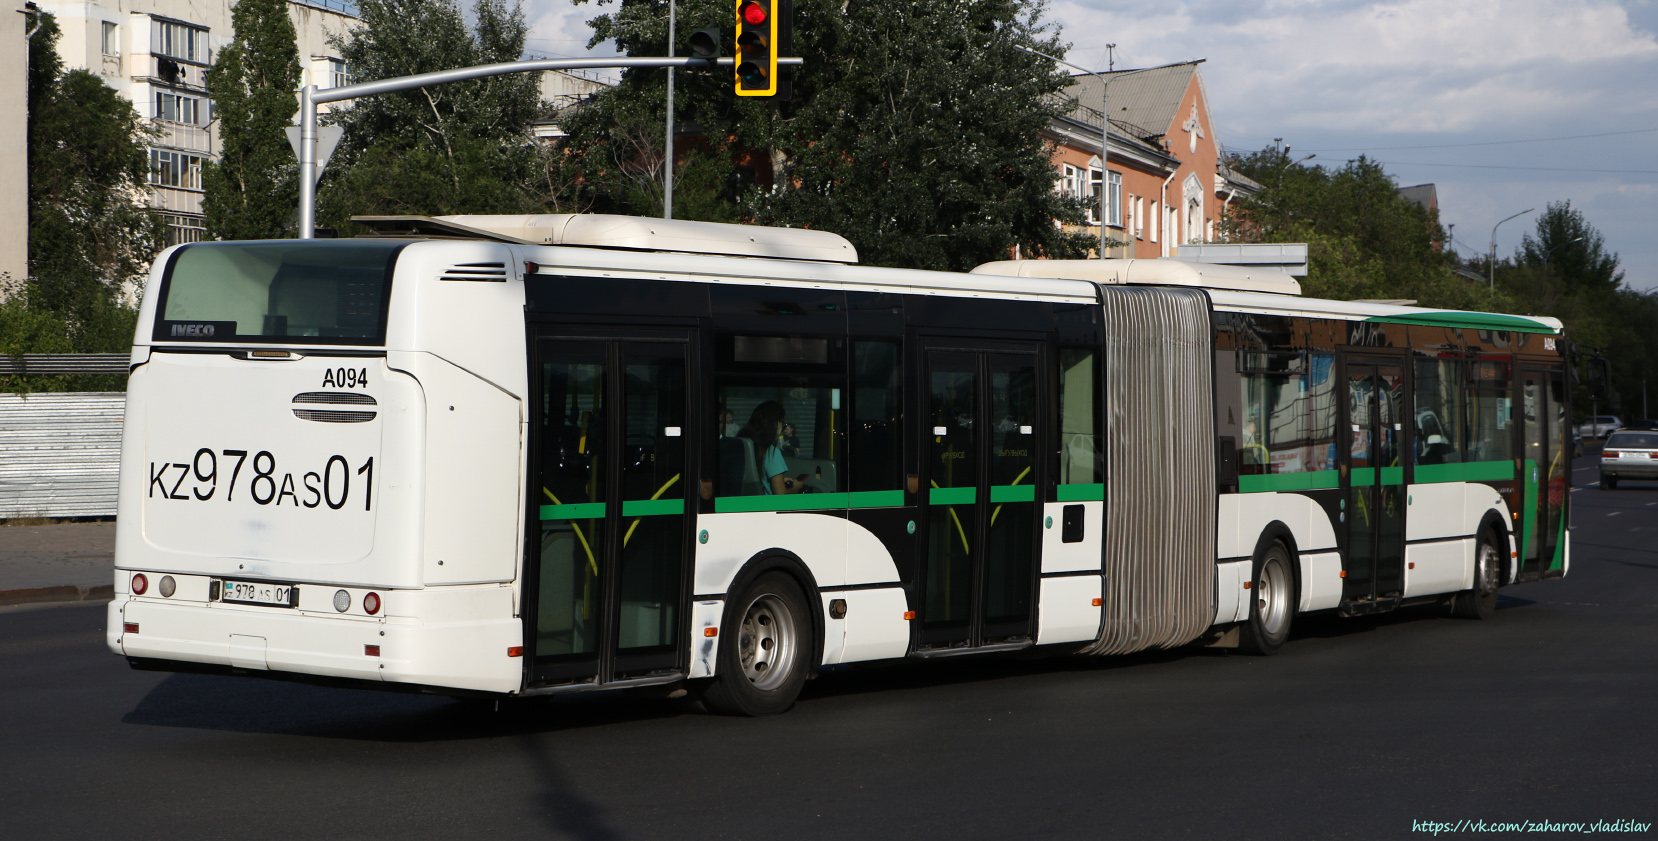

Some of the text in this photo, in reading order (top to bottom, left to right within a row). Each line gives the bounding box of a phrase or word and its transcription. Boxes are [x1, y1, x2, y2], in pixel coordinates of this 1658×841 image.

[171, 324, 215, 337] IVECO
[322, 367, 368, 388] A094
[235, 583, 255, 599] 978
[276, 587, 290, 602] 01
